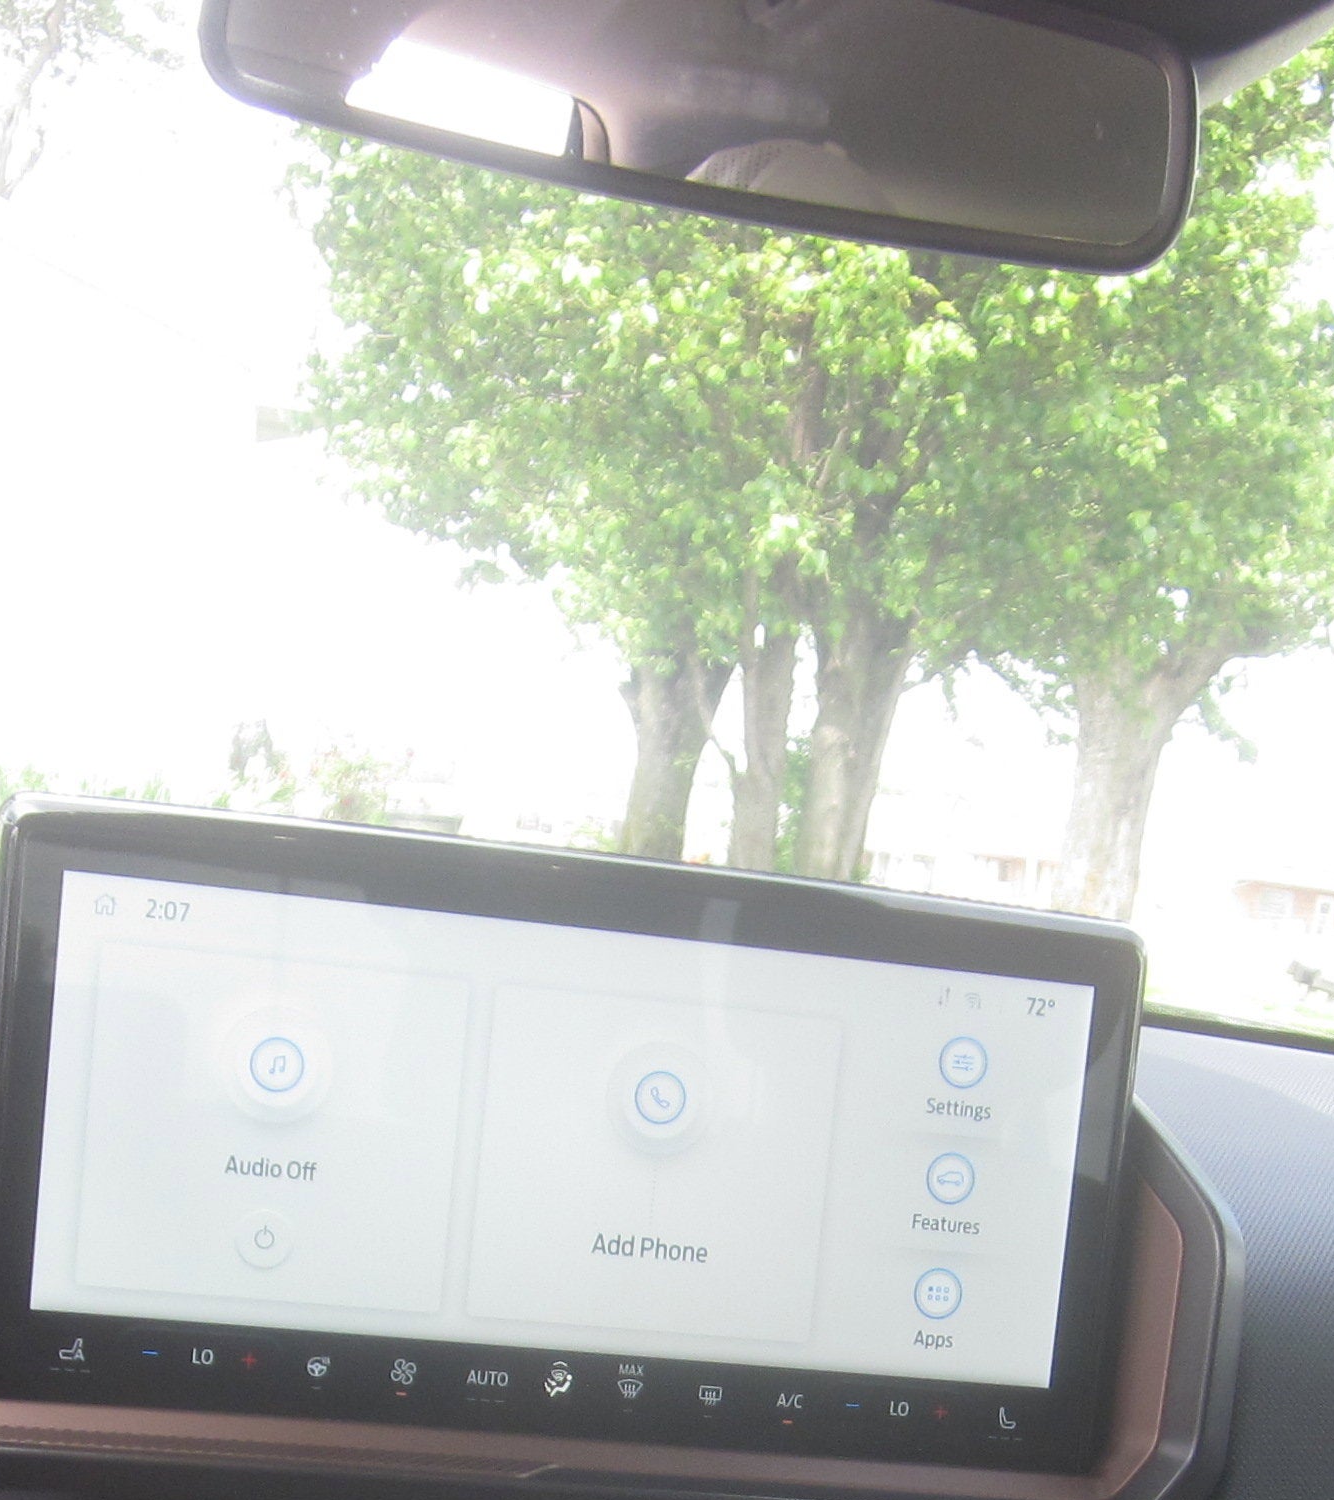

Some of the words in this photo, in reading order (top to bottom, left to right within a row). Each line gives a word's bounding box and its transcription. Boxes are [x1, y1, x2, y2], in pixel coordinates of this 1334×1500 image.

[144, 898, 191, 922] 2:07
[1025, 996, 1056, 1017] 72°
[925, 1098, 992, 1122] Settings
[224, 1155, 283, 1179] Audio
[286, 1159, 318, 1182] Off
[911, 1213, 981, 1236] Features
[591, 1232, 636, 1257] Add
[640, 1237, 709, 1264] Phone
[913, 1329, 954, 1350] Apps
[191, 1347, 214, 1366] LO
[466, 1369, 509, 1388] AUTO
[618, 1363, 645, 1376] MAX
[776, 1392, 804, 1410] A/C
[889, 1401, 911, 1418] LO
